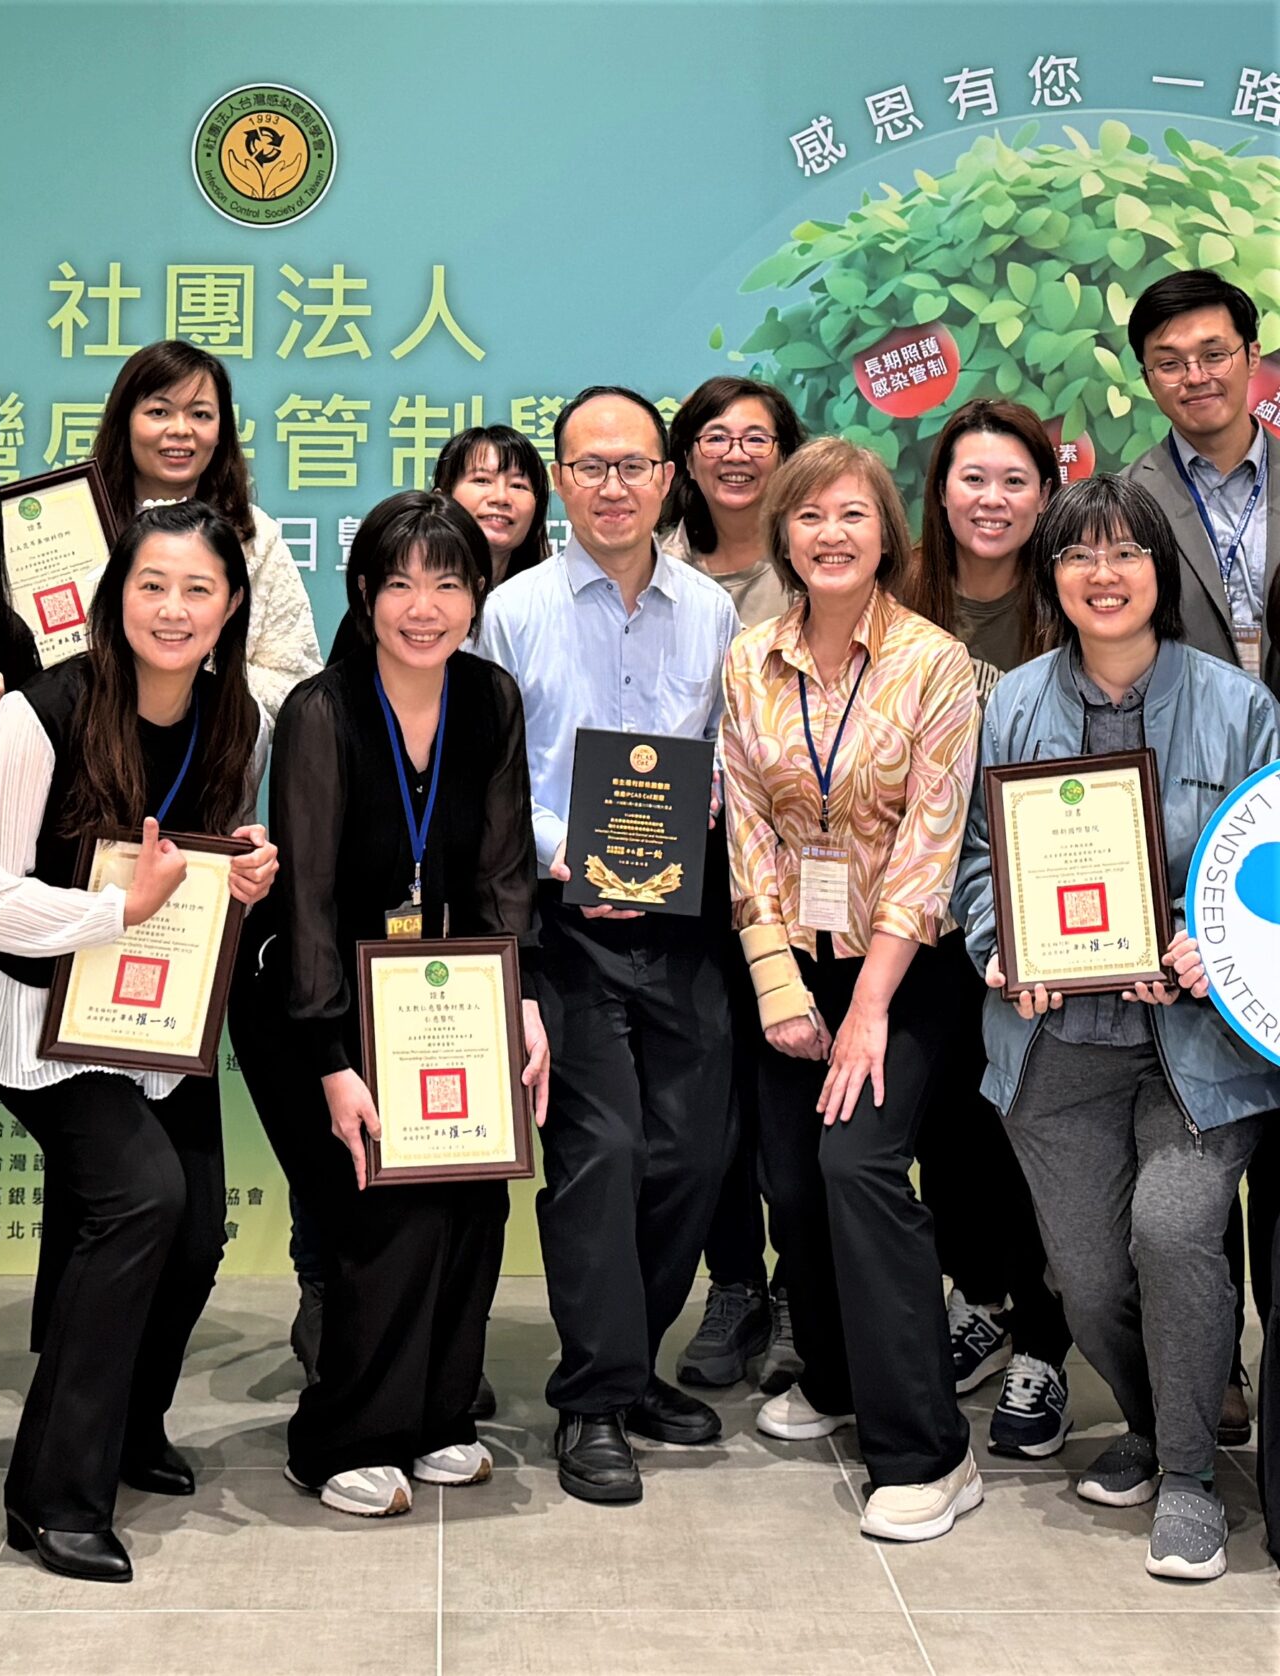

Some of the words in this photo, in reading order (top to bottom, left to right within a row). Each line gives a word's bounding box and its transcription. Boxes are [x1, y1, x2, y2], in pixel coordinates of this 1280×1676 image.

[203, 93, 325, 151] 社團法人台灣感染管制學會
[249, 114, 280, 126] 1993
[789, 54, 1082, 178] 感恩有您
[204, 169, 228, 204] Infection
[230, 200, 260, 218] Control
[265, 203, 296, 218] Society
[296, 196, 306, 206] of
[304, 169, 325, 197] Taiwan
[47, 262, 487, 362] 社團法人
[864, 336, 941, 378] 長期照護
[871, 356, 948, 398] 感染管制
[1202, 793, 1272, 945] LANDSEED
